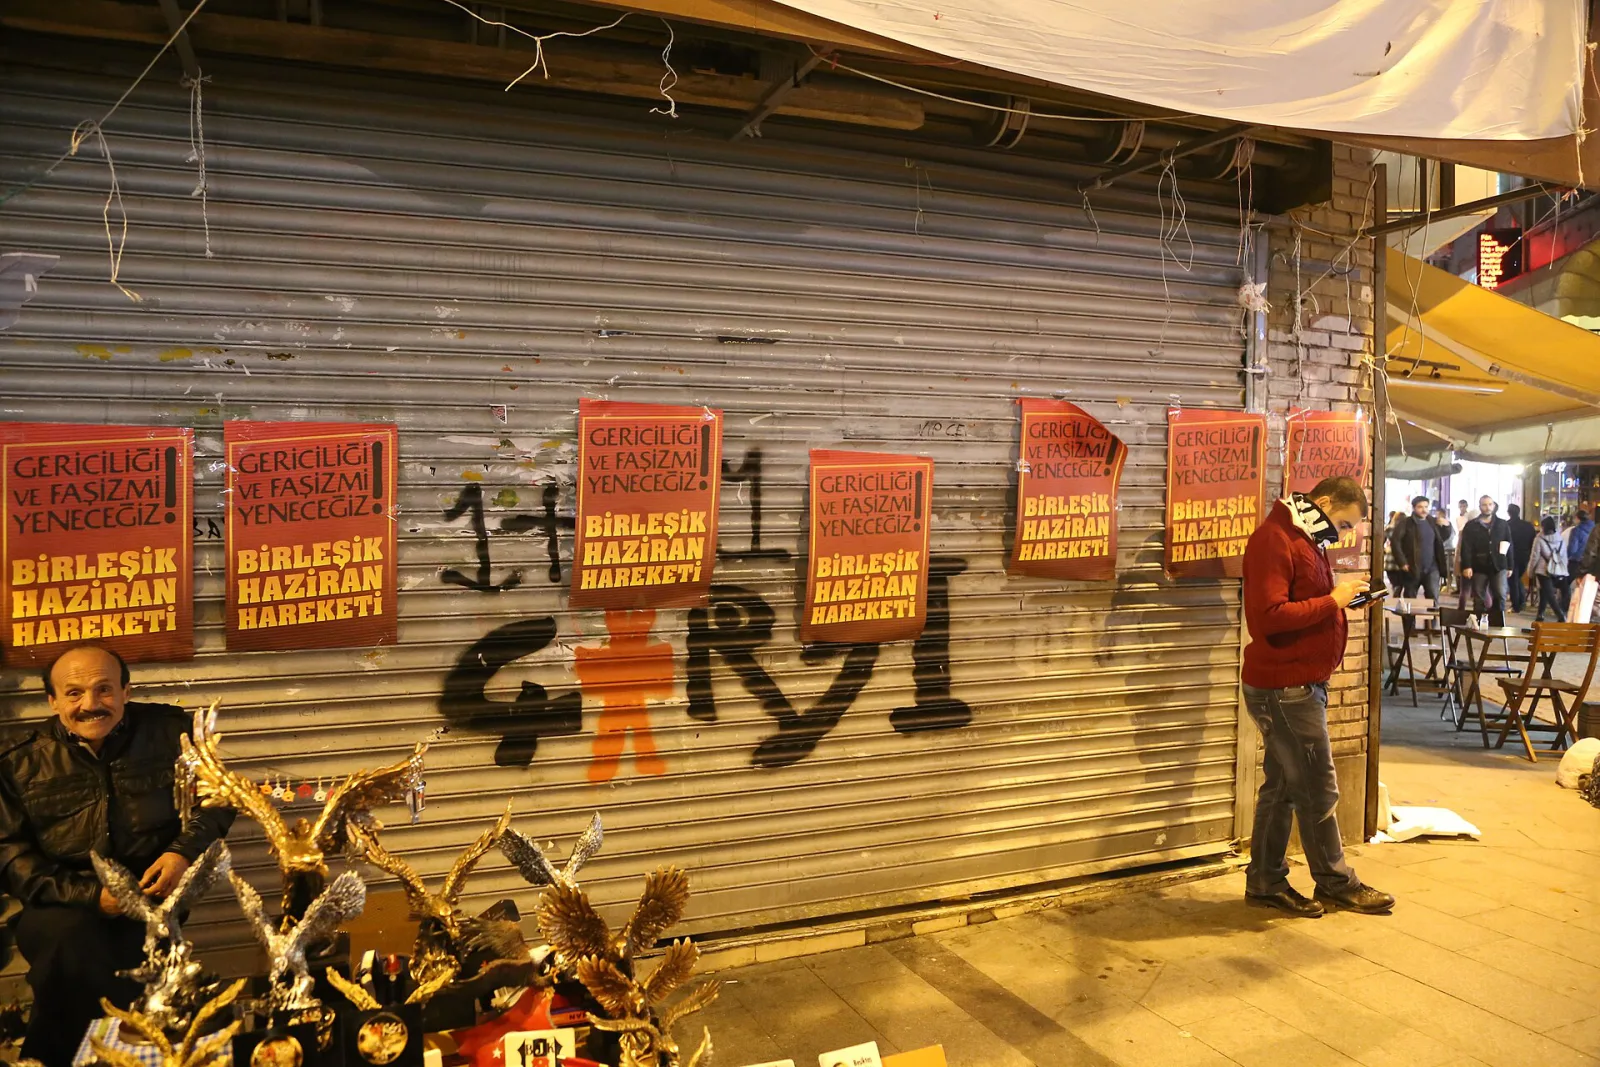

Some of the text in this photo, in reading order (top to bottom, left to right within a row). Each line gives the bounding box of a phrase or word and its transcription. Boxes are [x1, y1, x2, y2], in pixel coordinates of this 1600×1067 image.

[589, 424, 698, 447] GERİCİLİĞİ
[1175, 426, 1251, 448] GERİCİLİĞİ
[14, 447, 160, 478] GERİCİLİĞİ
[238, 442, 368, 473] GERİCİLİĞİ
[589, 448, 697, 473] VE FAŞİZMİ
[1029, 441, 1106, 460] VE FAŞİZMİ
[1175, 446, 1249, 468] VE FAŞİZMİ
[588, 471, 697, 494] YENECEĞİZ
[820, 471, 912, 493] GERİCİLİĞİ
[1029, 460, 1102, 479] YENECEĞİZ
[1175, 466, 1249, 486] YENECEĞİZ
[14, 475, 160, 506] VE FAŞİZMİ
[238, 470, 368, 499] VE FAŞİZMİ
[13, 502, 159, 534] YENECEĞİZ
[238, 494, 368, 526] YENECEĞİZ
[820, 494, 912, 516] VE FAŞİZMİ
[1024, 491, 1110, 518] BİRLEŞİK
[1173, 494, 1256, 520] BİRLEŞİK
[585, 508, 706, 538] BİRLEŞİK
[819, 514, 912, 537] YENECEĞİZ
[1022, 515, 1109, 541] HAZİRAN
[1172, 518, 1256, 543] HAZİRAN
[237, 536, 383, 570] BİRLEŞİK
[583, 535, 705, 566] HAZİRAN
[1018, 535, 1109, 561] HAREKETİ
[1172, 538, 1249, 562] HAREKET
[12, 546, 177, 582] BİRLEŞİK
[580, 560, 702, 590] HAREKETİ
[816, 549, 920, 578] BİRLEŞİK
[12, 577, 177, 618] HAZİRAN
[237, 565, 383, 604] HAZİRAN
[814, 574, 918, 603] HAZİRAN
[237, 591, 383, 630] HAREKETİ
[811, 596, 916, 625] HAREKETİ
[12, 606, 177, 646] HAREKETİ
[526, 1040, 555, 1057] BJK
